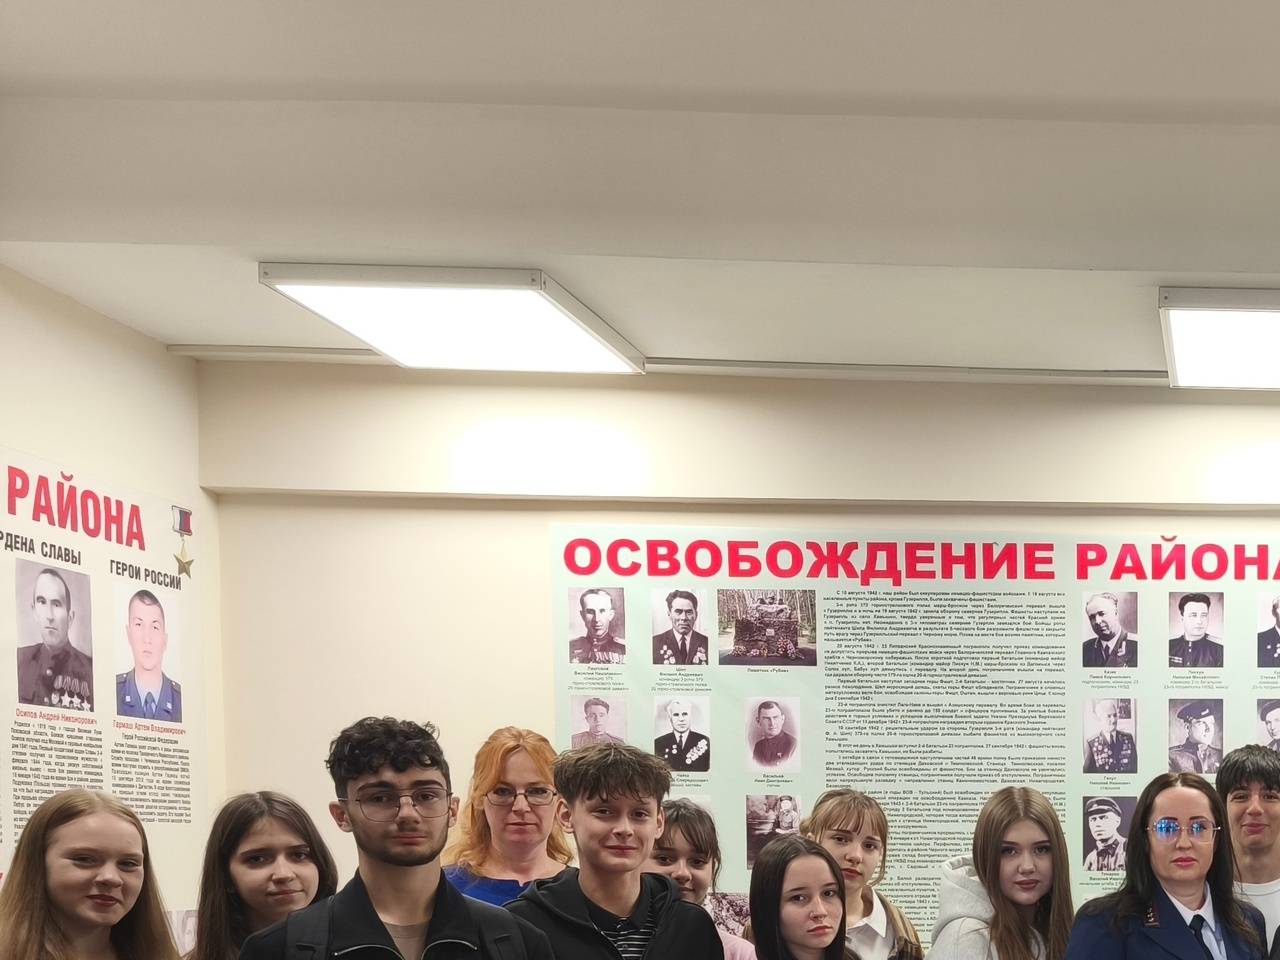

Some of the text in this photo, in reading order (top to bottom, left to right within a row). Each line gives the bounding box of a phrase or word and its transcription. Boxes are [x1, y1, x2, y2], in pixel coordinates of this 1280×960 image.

[8, 465, 145, 551] РАЙОНА
[40, 541, 82, 566] СЛАВЫ
[563, 538, 1056, 587] ОСВОБОЖДЕНИЕ
[110, 559, 182, 591] ГЕРОИ РОССИИ
